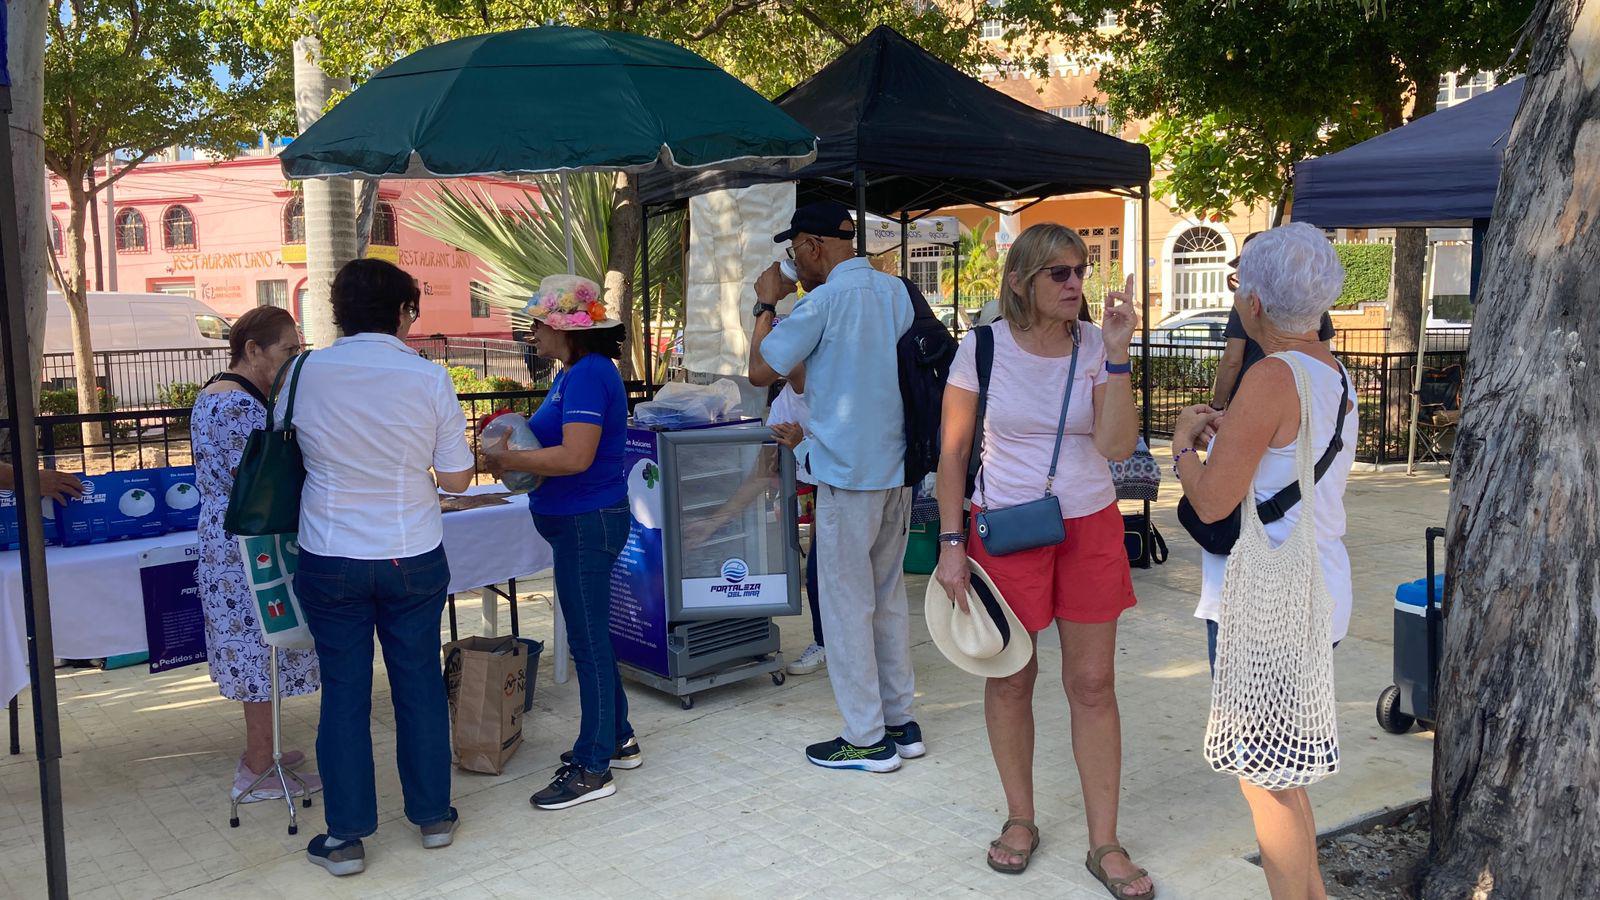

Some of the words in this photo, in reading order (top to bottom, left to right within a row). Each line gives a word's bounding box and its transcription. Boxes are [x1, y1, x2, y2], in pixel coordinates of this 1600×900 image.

[173, 253, 242, 271] RESTAURANT
[398, 249, 450, 267] RESTAURANT
[710, 583, 762, 594] FORTALEZA
[743, 590, 760, 598] MAR
[160, 653, 193, 667] Pedidos
